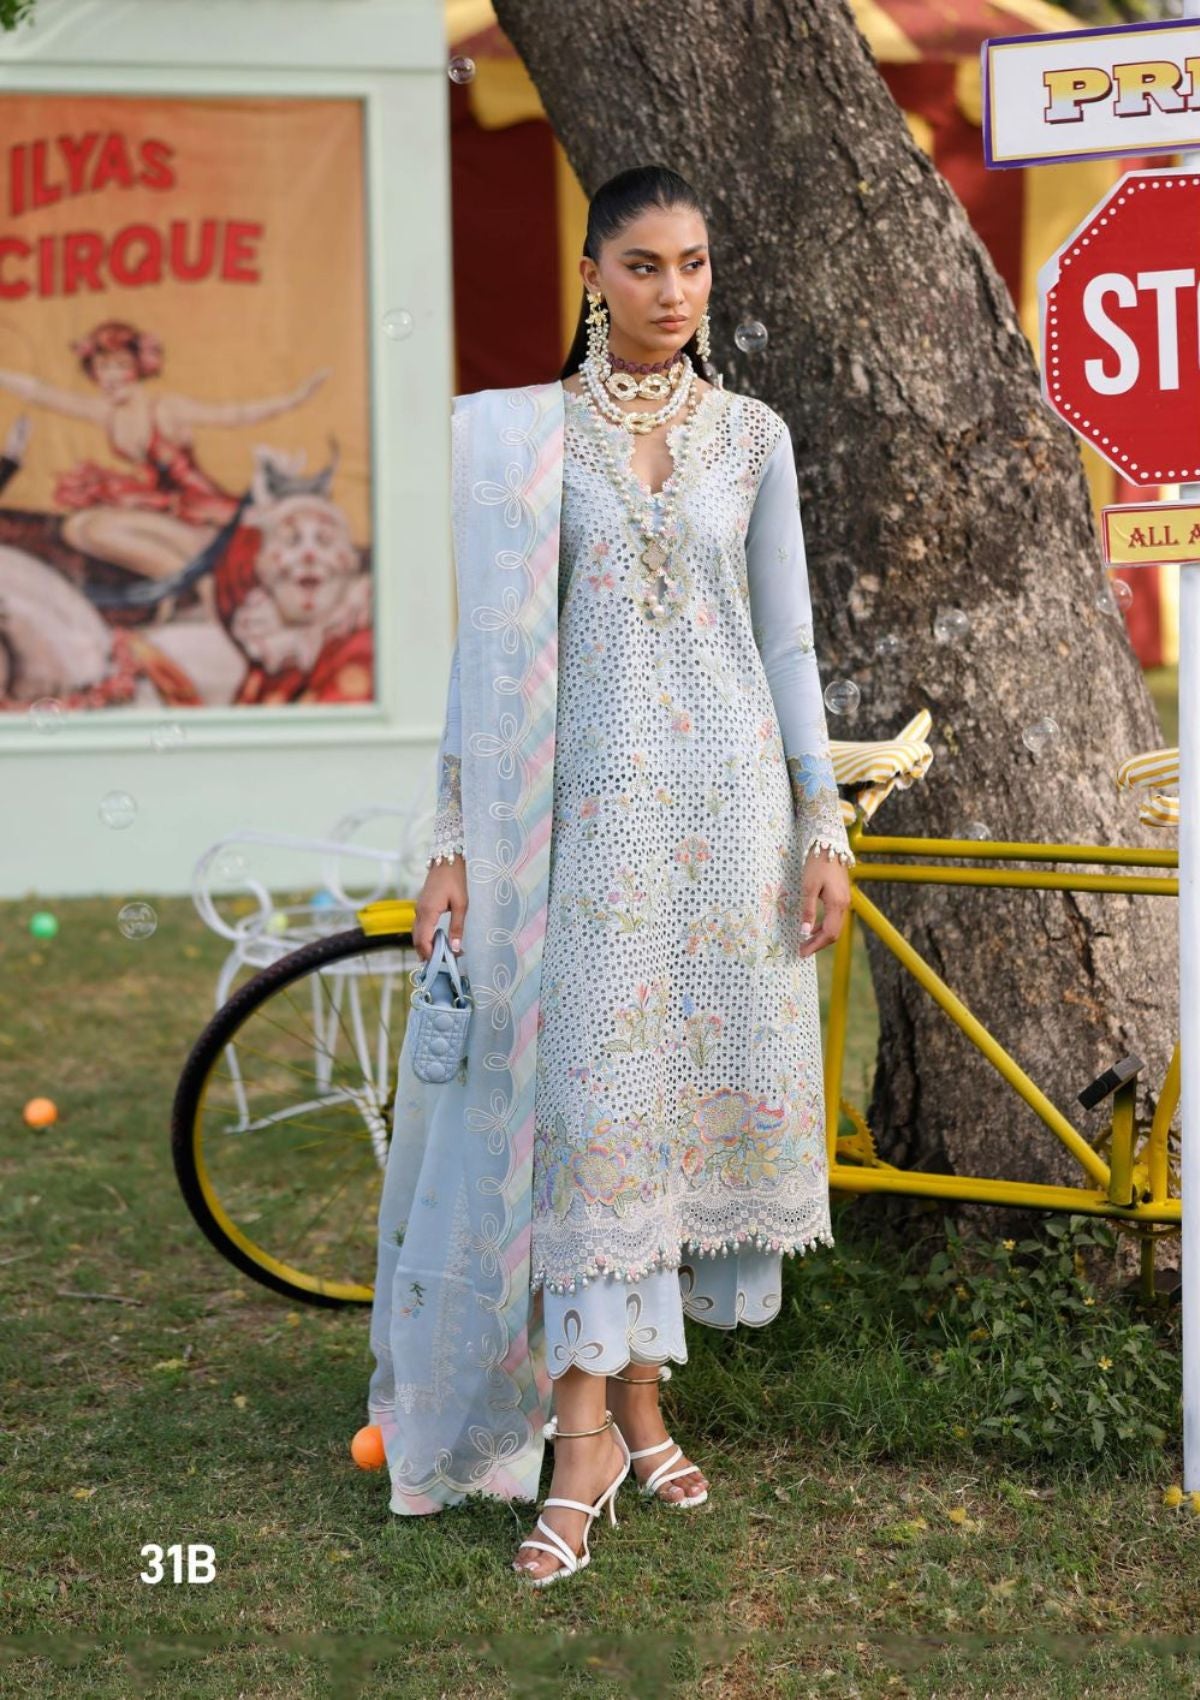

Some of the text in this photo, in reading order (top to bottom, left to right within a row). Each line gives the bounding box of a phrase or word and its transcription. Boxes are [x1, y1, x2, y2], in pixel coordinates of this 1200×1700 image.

[8, 131, 176, 218] ILYAS
[0, 218, 265, 300] CIRQUE
[1082, 268, 1200, 396] ST
[1128, 525, 1180, 549] ALL
